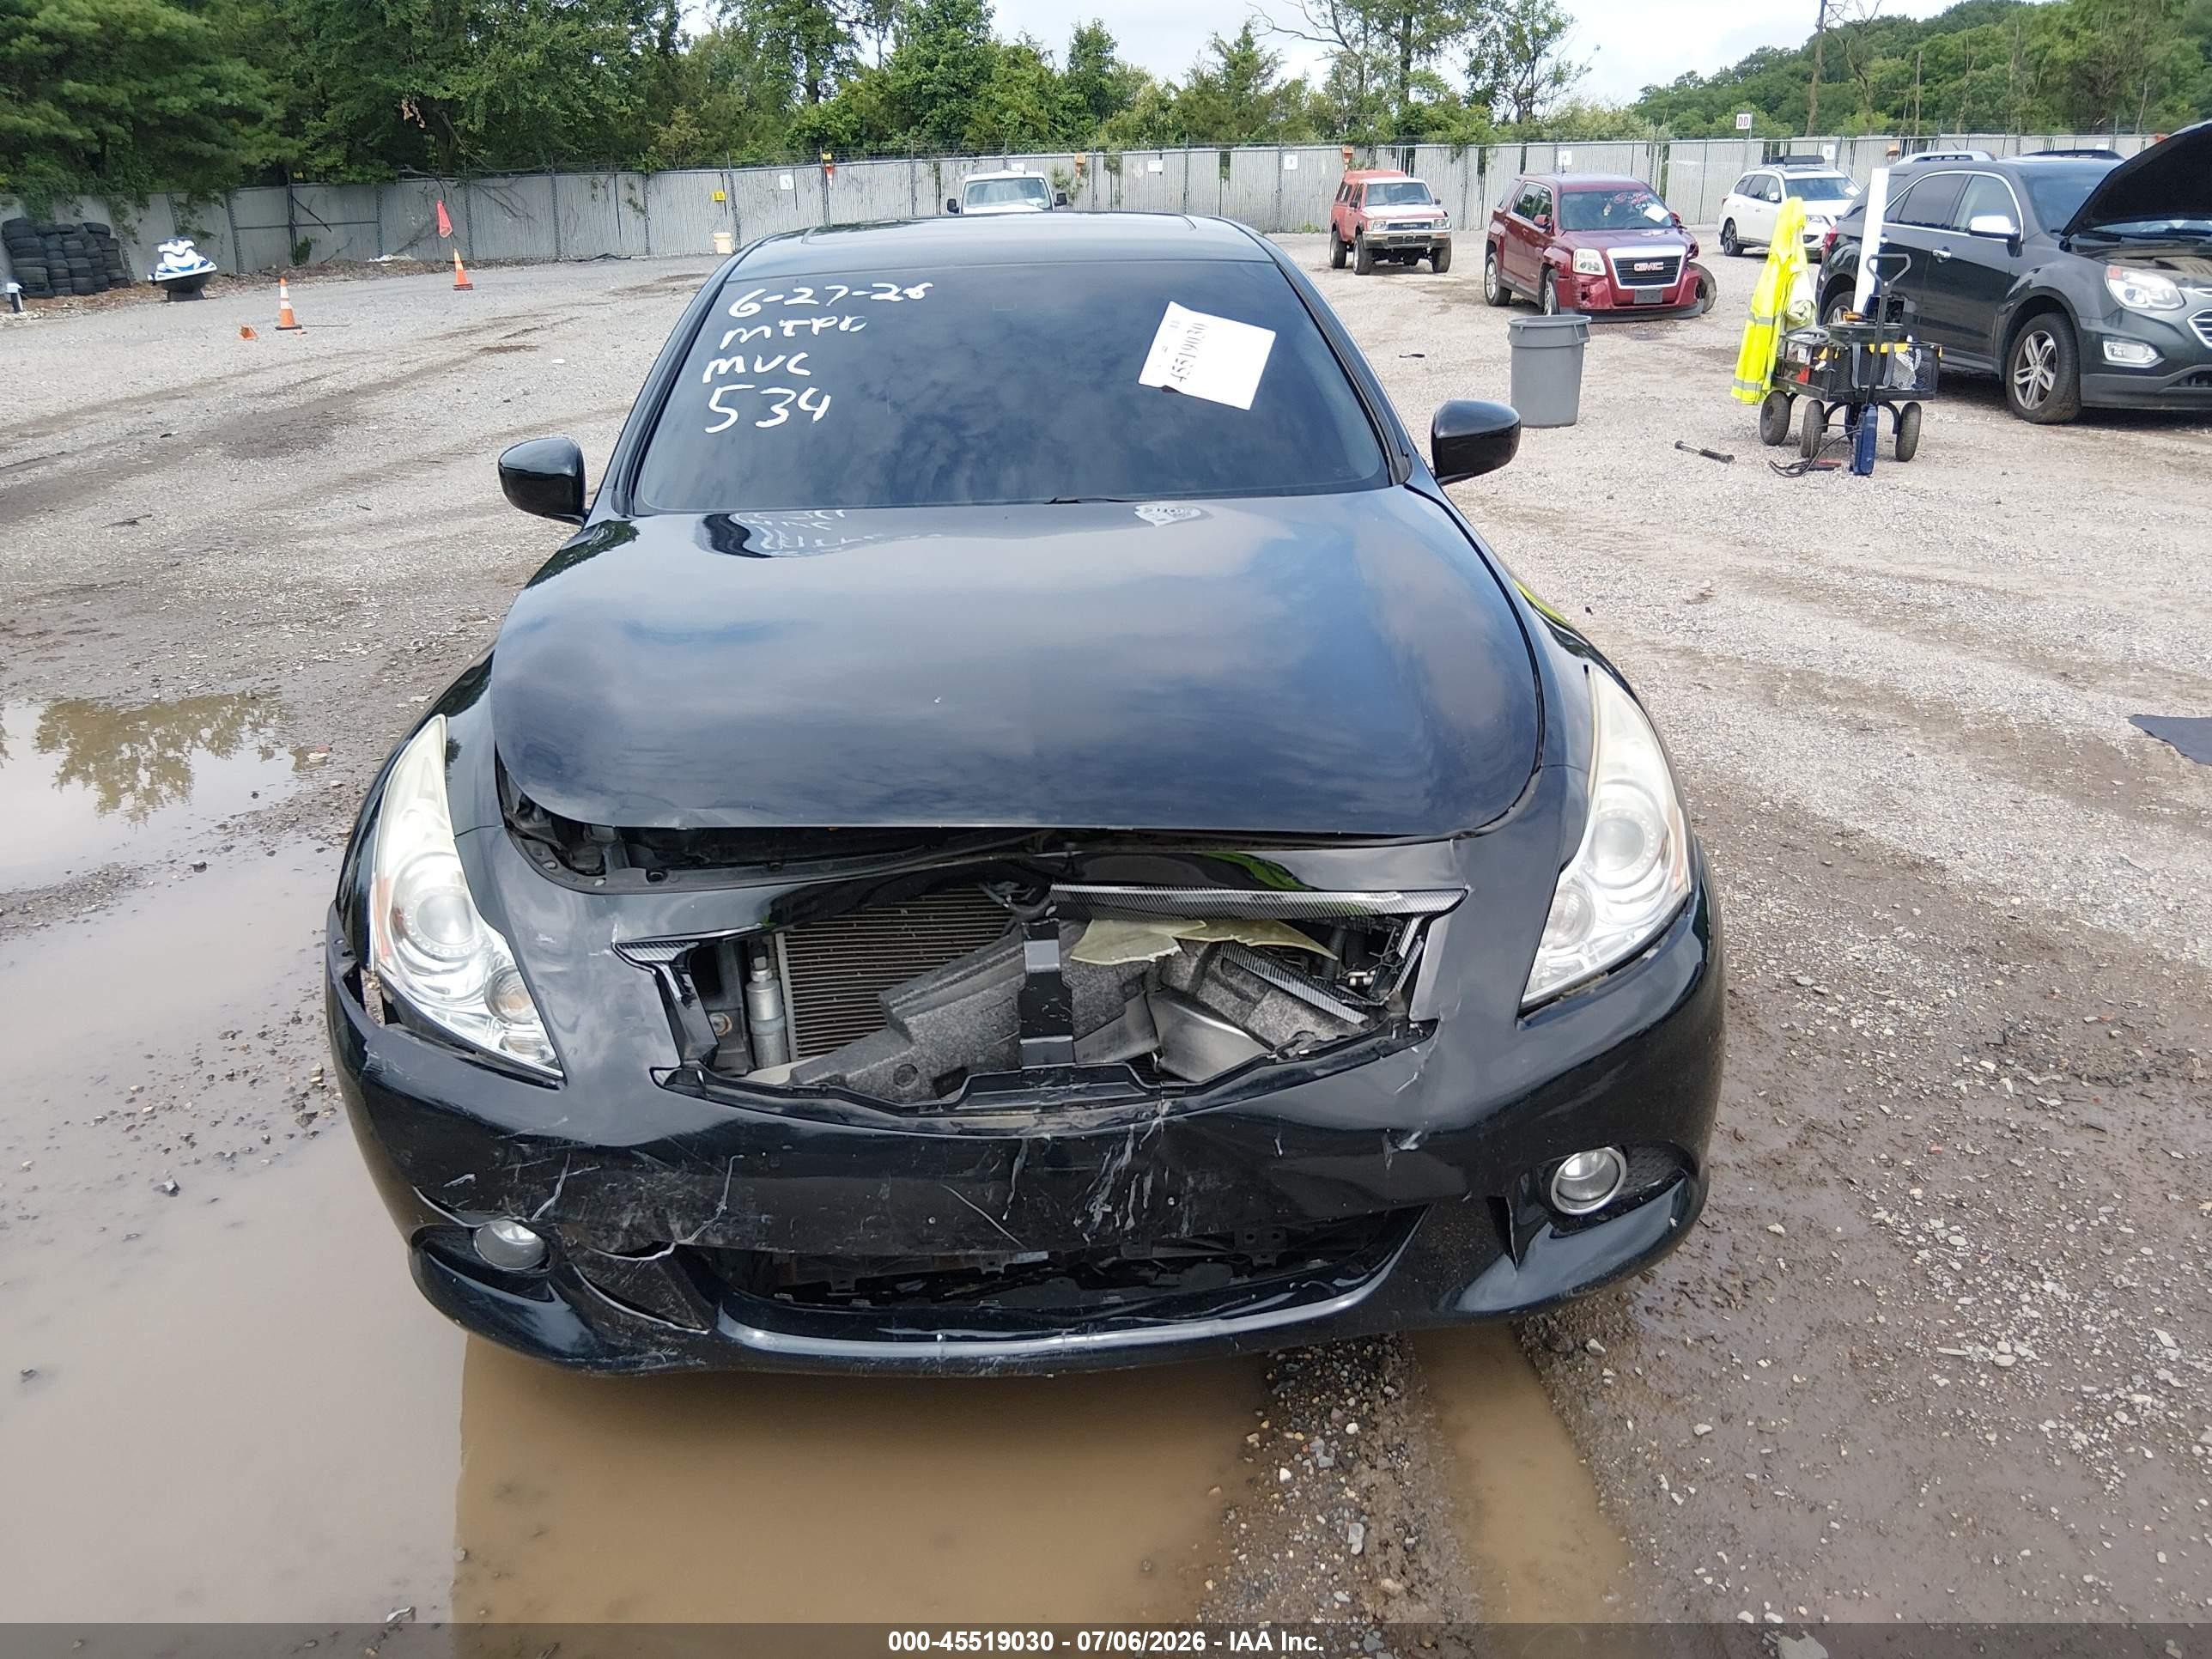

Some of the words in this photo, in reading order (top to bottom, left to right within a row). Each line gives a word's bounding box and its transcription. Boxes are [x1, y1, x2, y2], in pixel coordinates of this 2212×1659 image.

[1738, 116, 1749, 127] DD
[1634, 261, 1664, 272] GMC
[702, 352, 811, 384] MVC
[704, 384, 832, 434] 534
